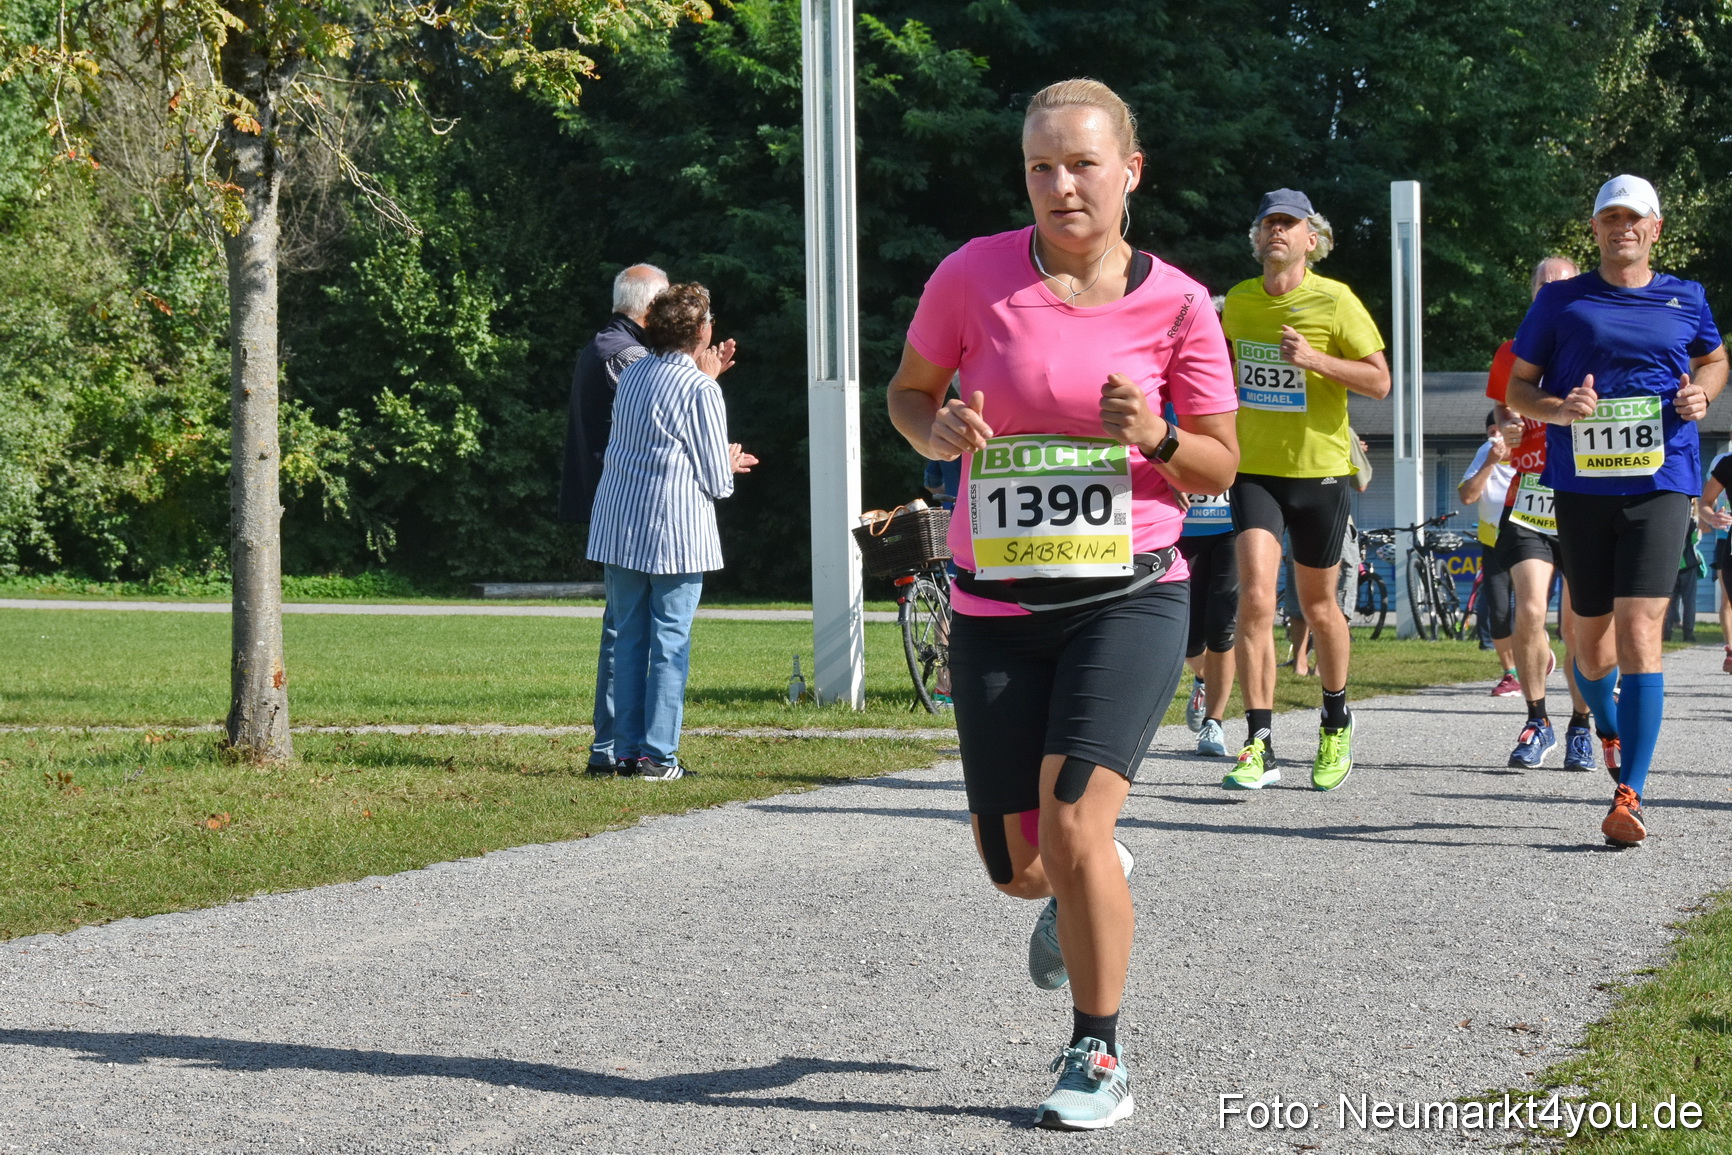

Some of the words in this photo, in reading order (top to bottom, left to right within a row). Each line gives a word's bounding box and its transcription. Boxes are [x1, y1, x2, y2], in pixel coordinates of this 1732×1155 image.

[1167, 303, 1190, 338] Reebok
[1241, 343, 1281, 361] BOC
[1244, 365, 1296, 389] 2632
[1246, 391, 1293, 404] MICHAEL
[1583, 424, 1653, 450] 1118
[983, 440, 1116, 474] BOCK
[1586, 455, 1650, 468] ANDREAS
[987, 483, 1113, 529] 1390
[1192, 508, 1227, 517] INGRID
[1003, 540, 1118, 564] SABRINA
